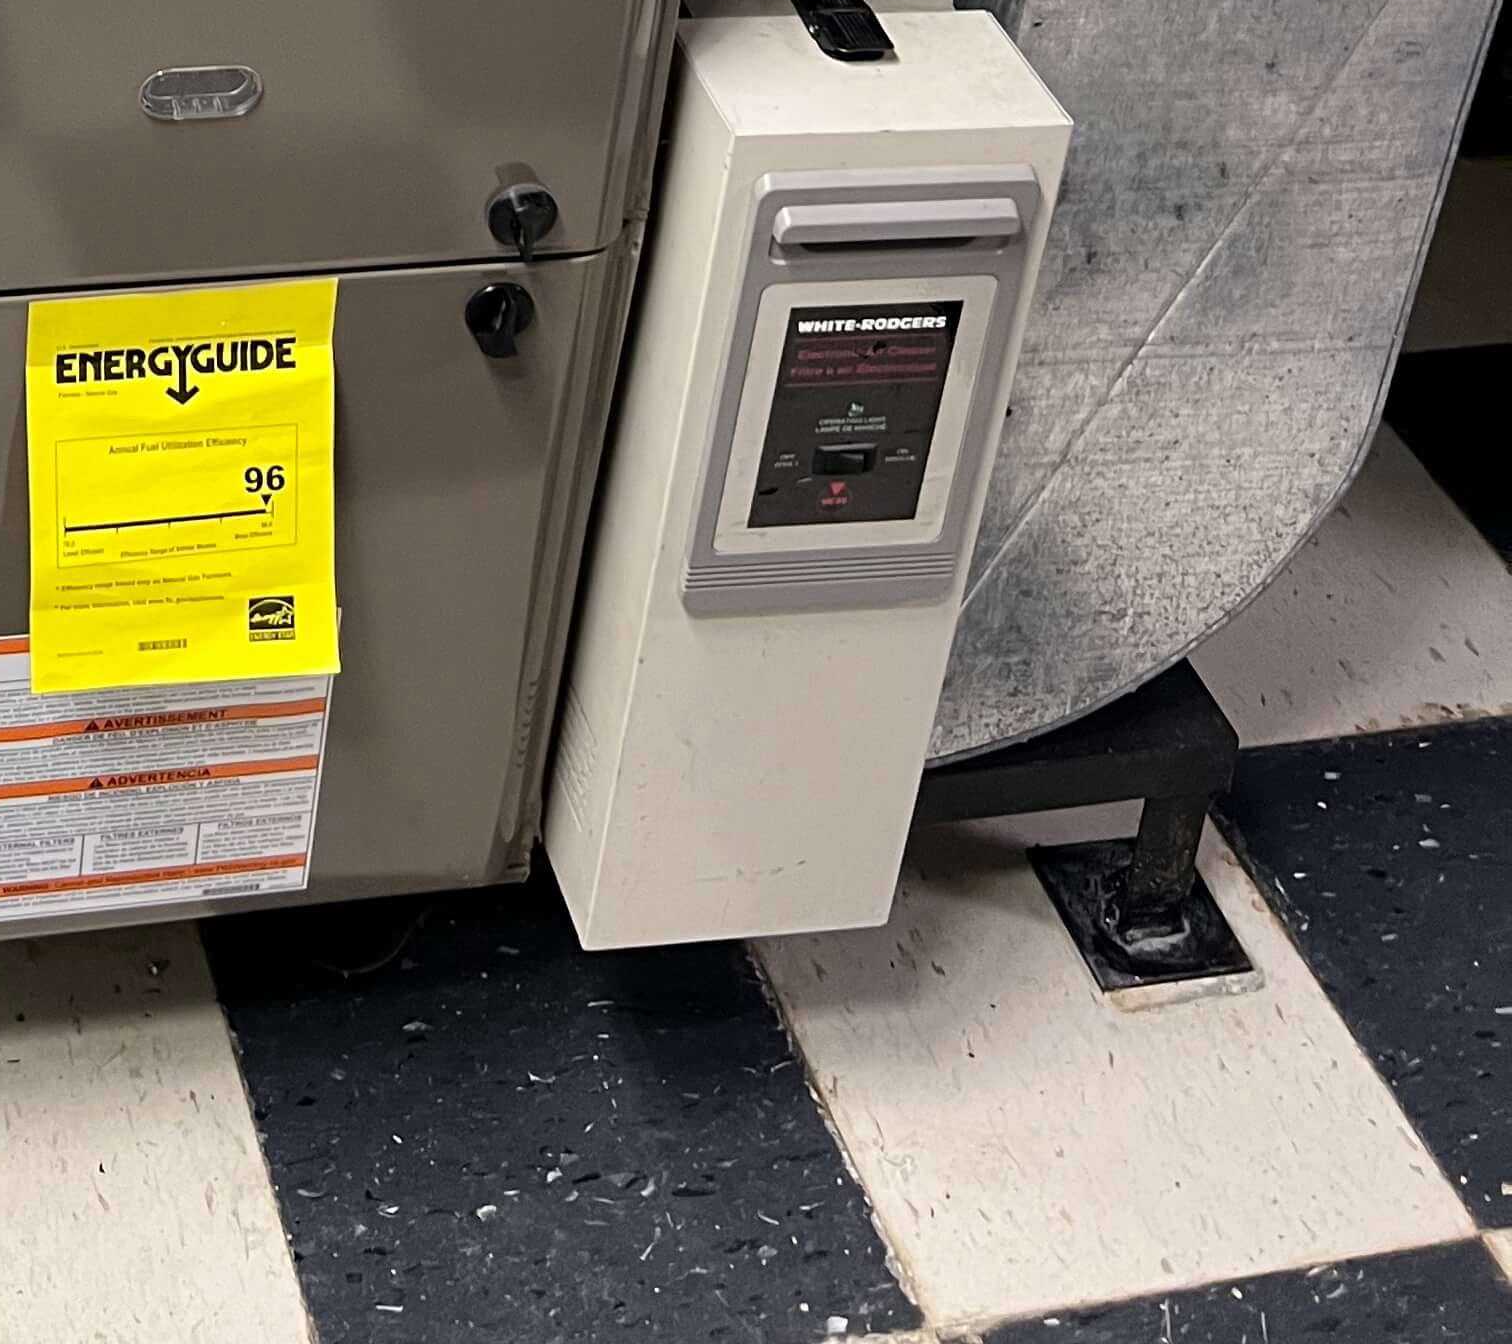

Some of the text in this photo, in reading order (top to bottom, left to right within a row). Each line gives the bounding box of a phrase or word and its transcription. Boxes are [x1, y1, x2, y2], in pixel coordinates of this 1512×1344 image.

[55, 336, 297, 390] ENERGYGUIDE
[244, 465, 286, 494] 96
[103, 710, 227, 729] AVERTISSEMENT
[106, 768, 211, 787] ADVERTENCIA
